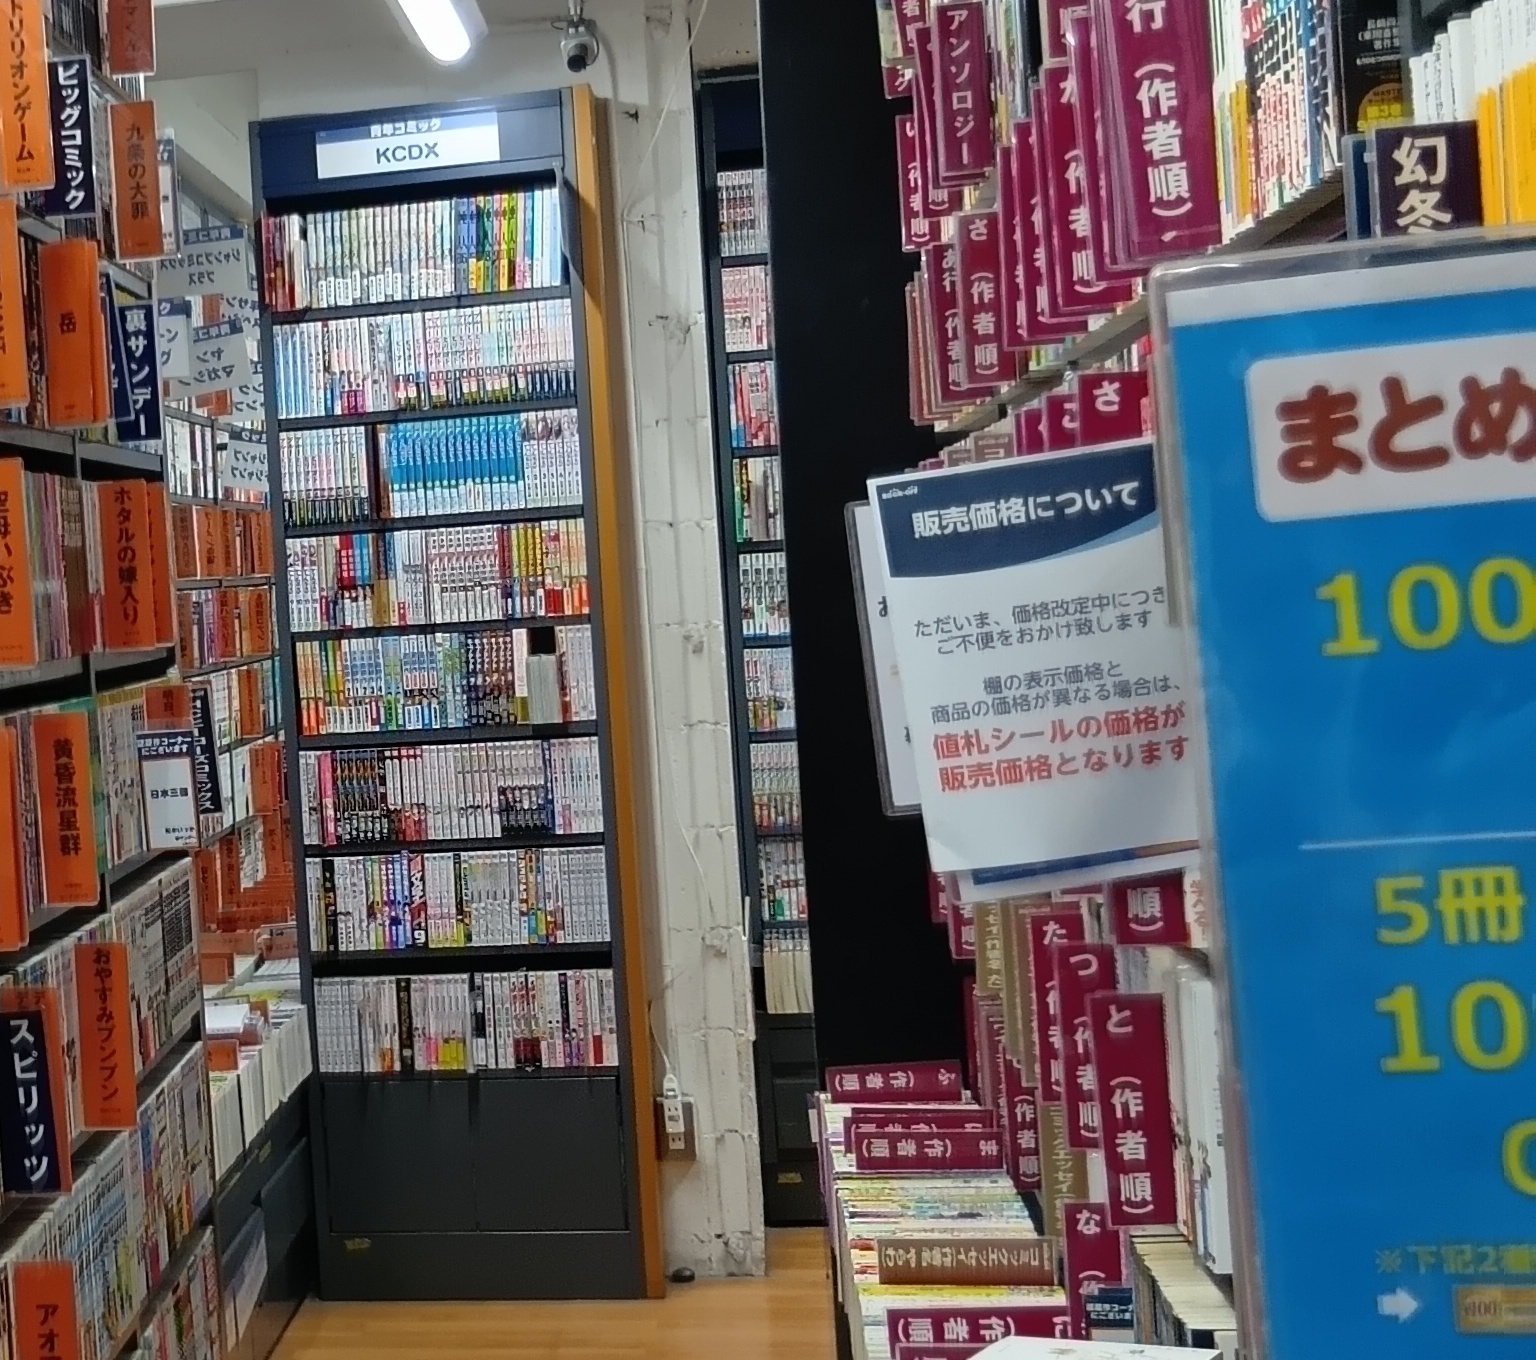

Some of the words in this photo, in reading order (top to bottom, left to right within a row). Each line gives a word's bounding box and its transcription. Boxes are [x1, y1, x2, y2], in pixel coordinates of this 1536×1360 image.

[947, 10, 977, 166] アンソロジー
[57, 62, 87, 210] ビッグコミック
[376, 141, 440, 165] KCDX
[124, 308, 152, 437] 裏サンデー
[911, 481, 1140, 539] 販売価格について
[914, 586, 1165, 639] ただいま、価格改定中につき
[937, 610, 1153, 655] ご不便をおかけ致します
[931, 676, 1181, 725] 商品の価格が異なる場合は、
[983, 661, 1124, 695] 棚の表示価格と
[932, 701, 1187, 760] 値札シールの価格が
[939, 737, 1190, 792] 販売価格となります
[1376, 865, 1522, 945] 5冊
[9, 1017, 50, 1180] スピリッツ
[1106, 1005, 1154, 1213] と（作者順）
